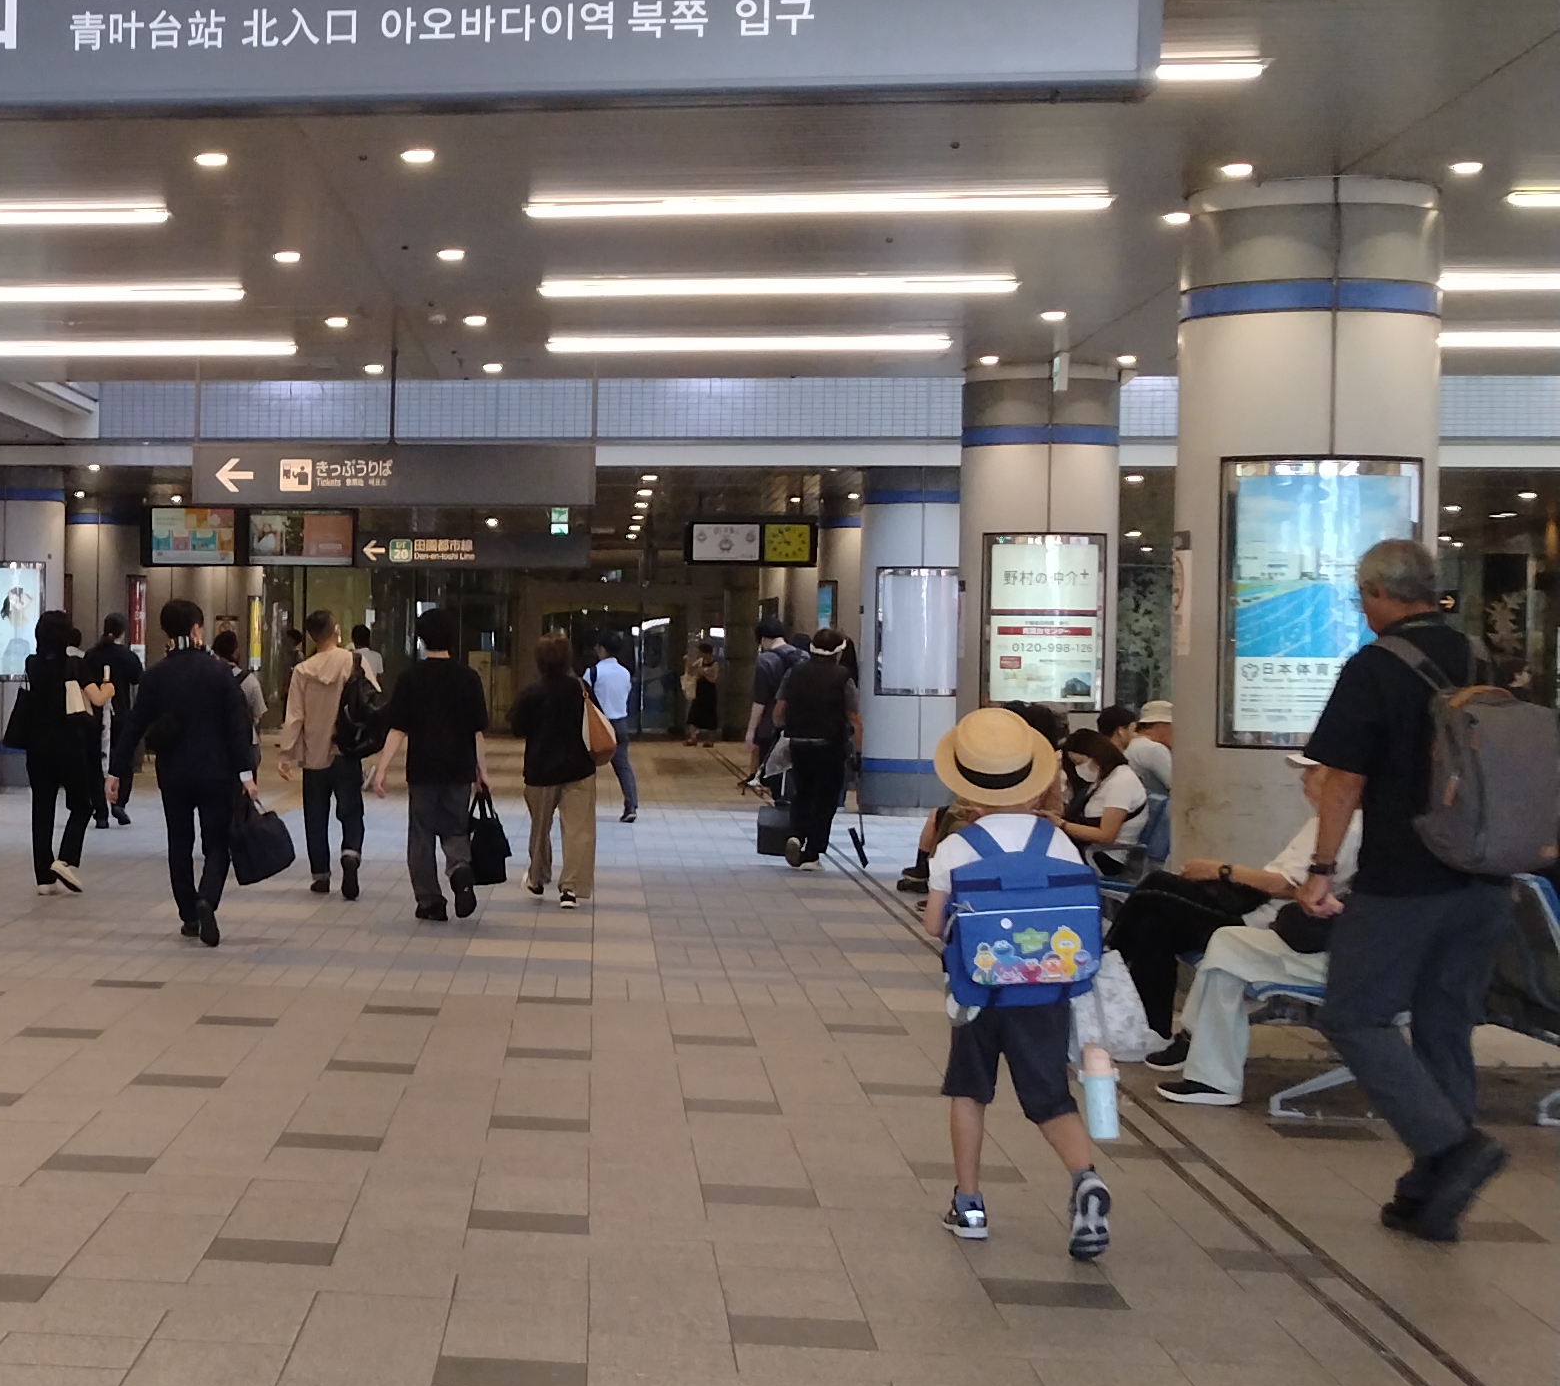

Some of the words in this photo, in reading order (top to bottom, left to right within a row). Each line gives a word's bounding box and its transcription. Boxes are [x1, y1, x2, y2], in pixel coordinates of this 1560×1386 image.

[69, 9, 226, 52] 青叶台站
[241, 7, 358, 48] 北入口
[381, 0, 614, 44] 아오바다이역
[628, 0, 709, 39] 북쪽
[315, 459, 393, 477] きっぷうりば
[393, 549, 409, 559] 20
[1011, 643, 1093, 653] 0120-998-126
